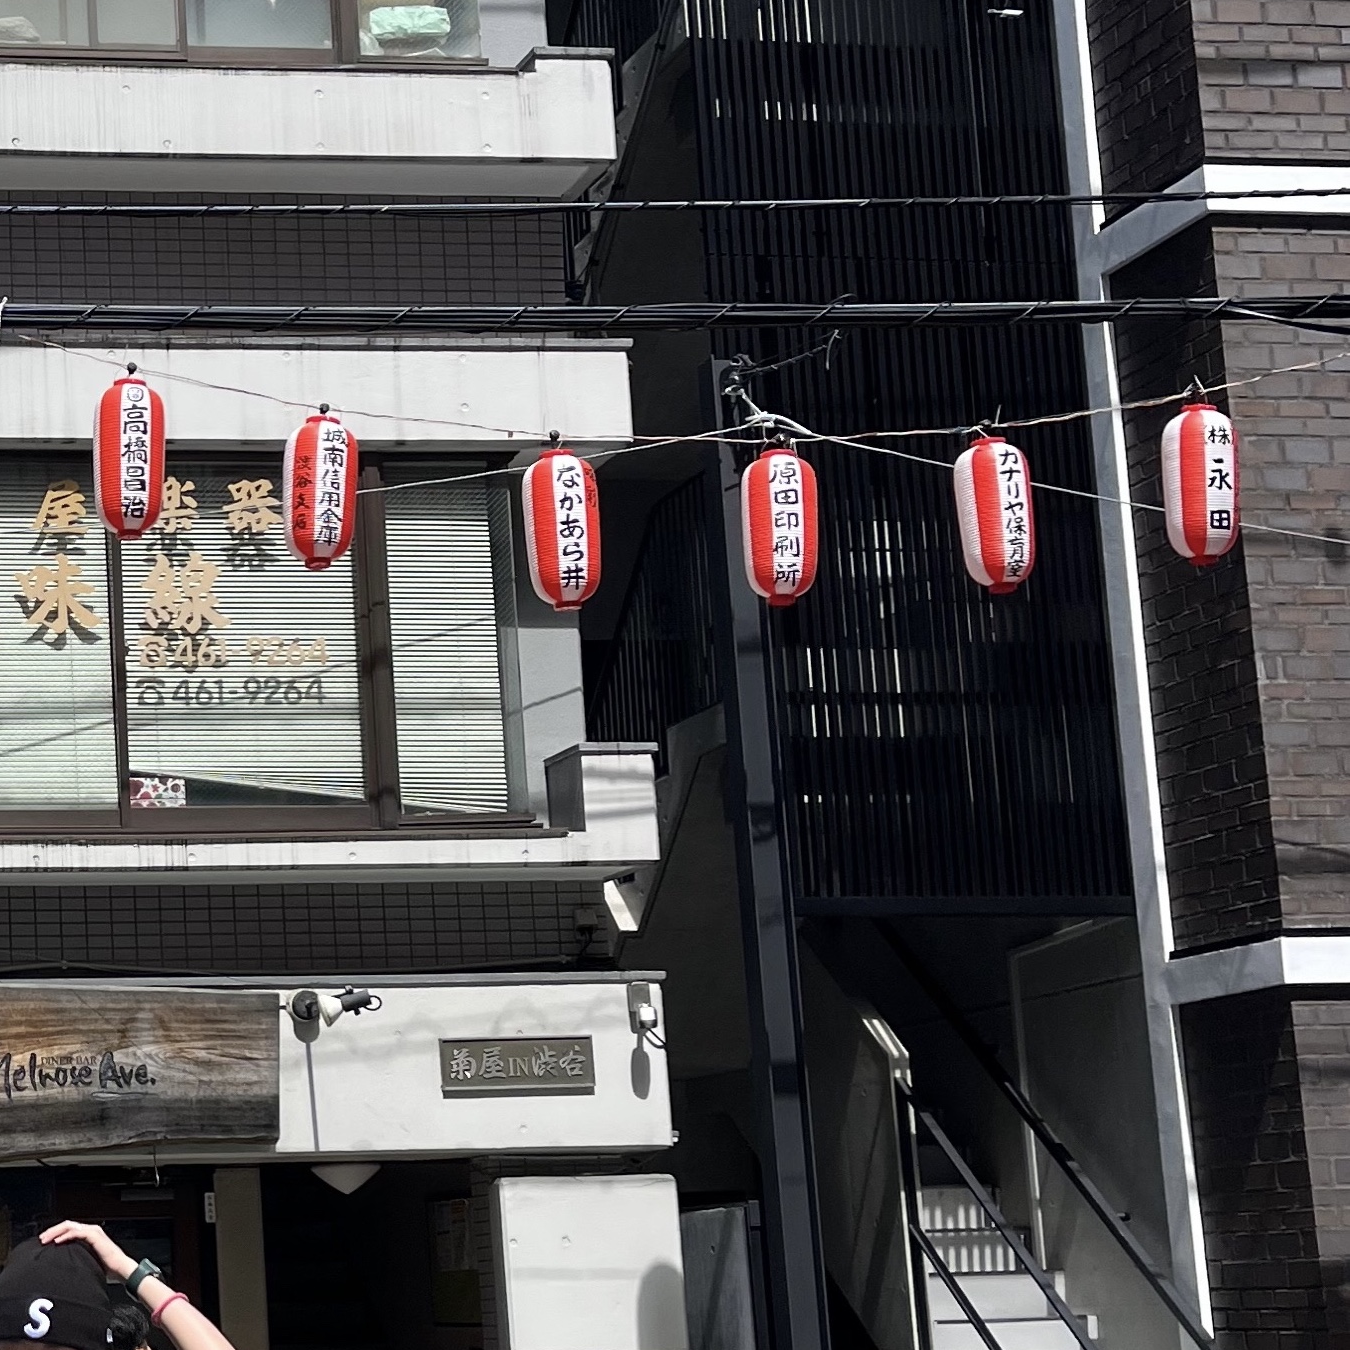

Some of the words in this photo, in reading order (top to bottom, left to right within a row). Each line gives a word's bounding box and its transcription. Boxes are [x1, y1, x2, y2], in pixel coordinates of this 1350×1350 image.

[121, 404, 148, 519] 高橋昌治
[315, 428, 350, 547] 城南信用金庫
[998, 449, 1027, 578] カナリヤ保育室
[557, 465, 587, 590] なかあら井
[769, 462, 801, 587] 原田印刷所
[174, 636, 330, 667] 461-9264
[40, 1056, 72, 1066] DINER
[76, 1056, 97, 1066] BAR
[99, 1050, 157, 1089] Ave.
[23, 1298, 54, 1339] S
